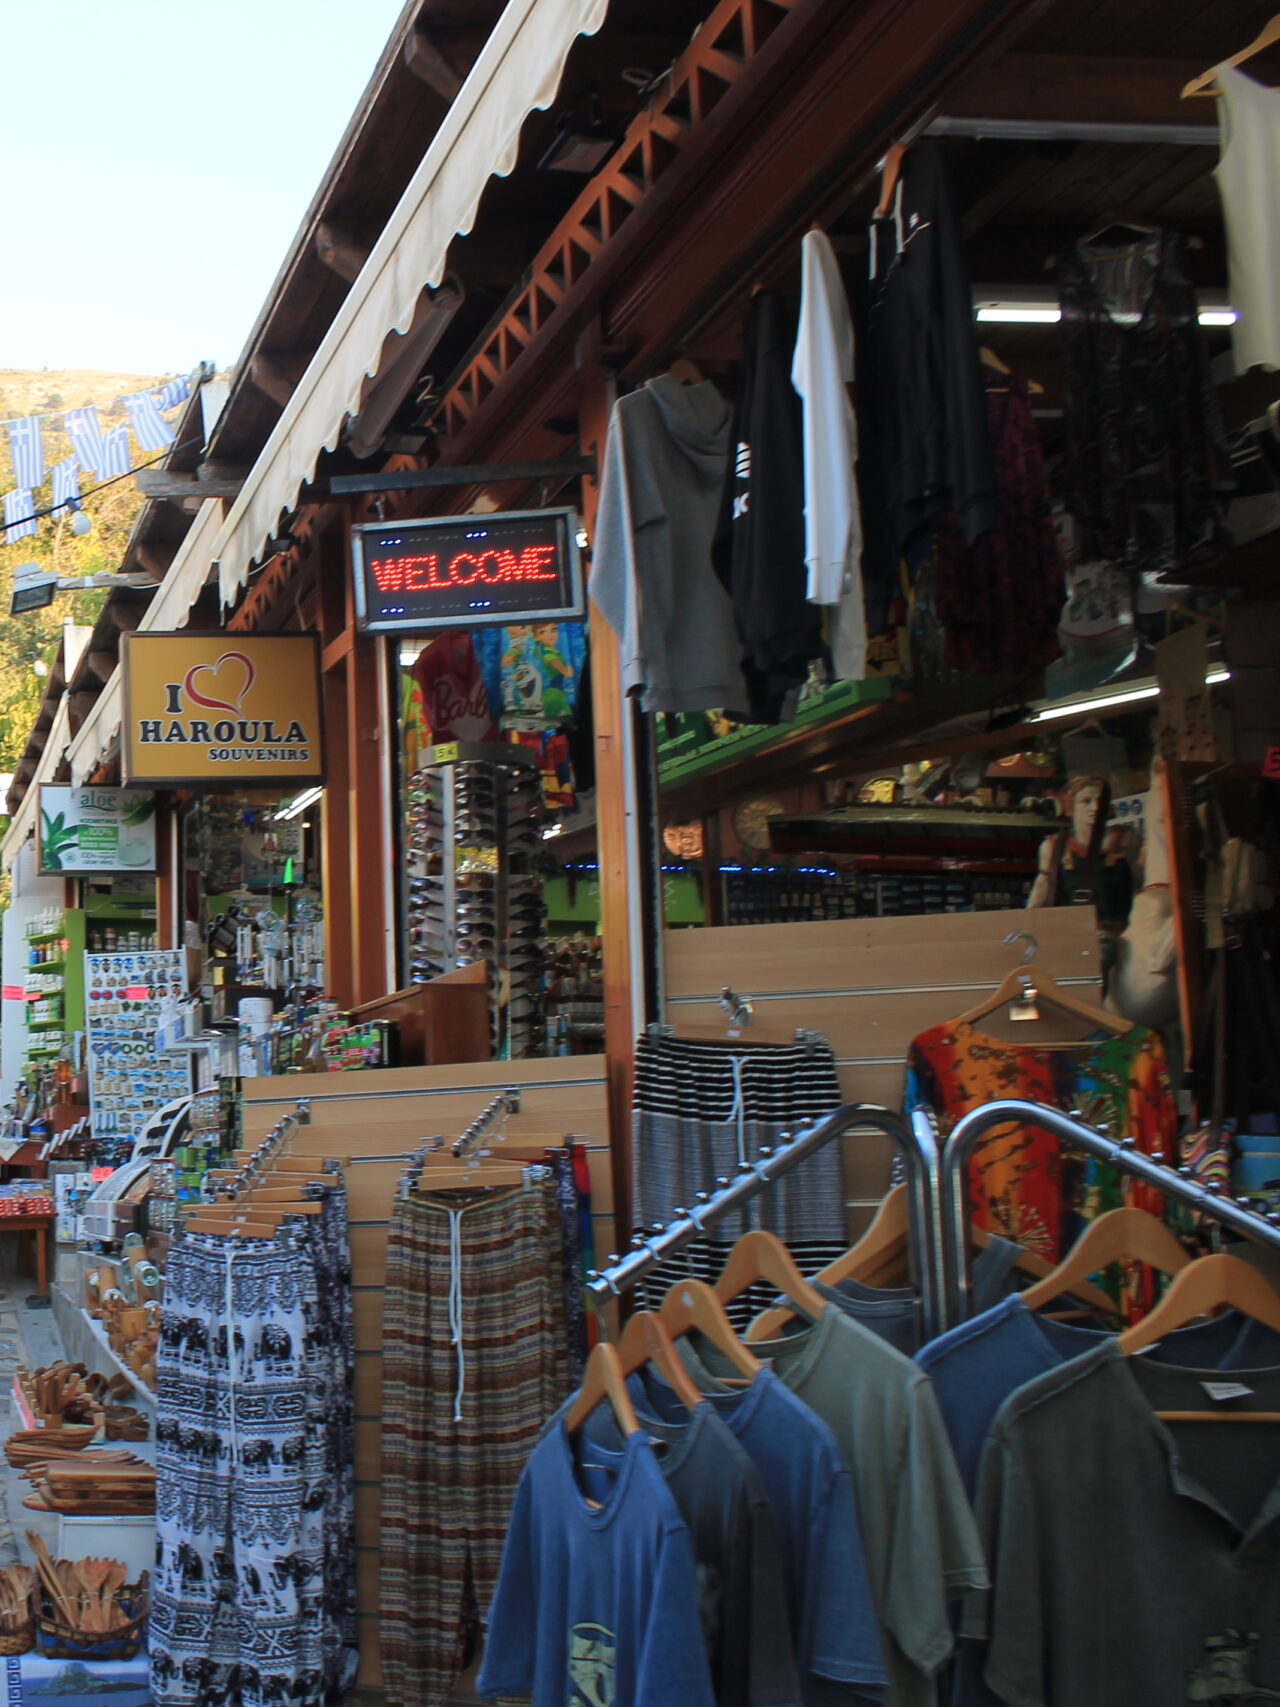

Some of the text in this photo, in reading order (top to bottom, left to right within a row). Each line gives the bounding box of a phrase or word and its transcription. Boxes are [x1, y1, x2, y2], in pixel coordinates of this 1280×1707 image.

[371, 546, 557, 591] WELCOME
[165, 684, 184, 714] I
[139, 720, 309, 743] HAROULA
[208, 748, 310, 762] SOUVENIRS
[81, 791, 117, 807] aloe
